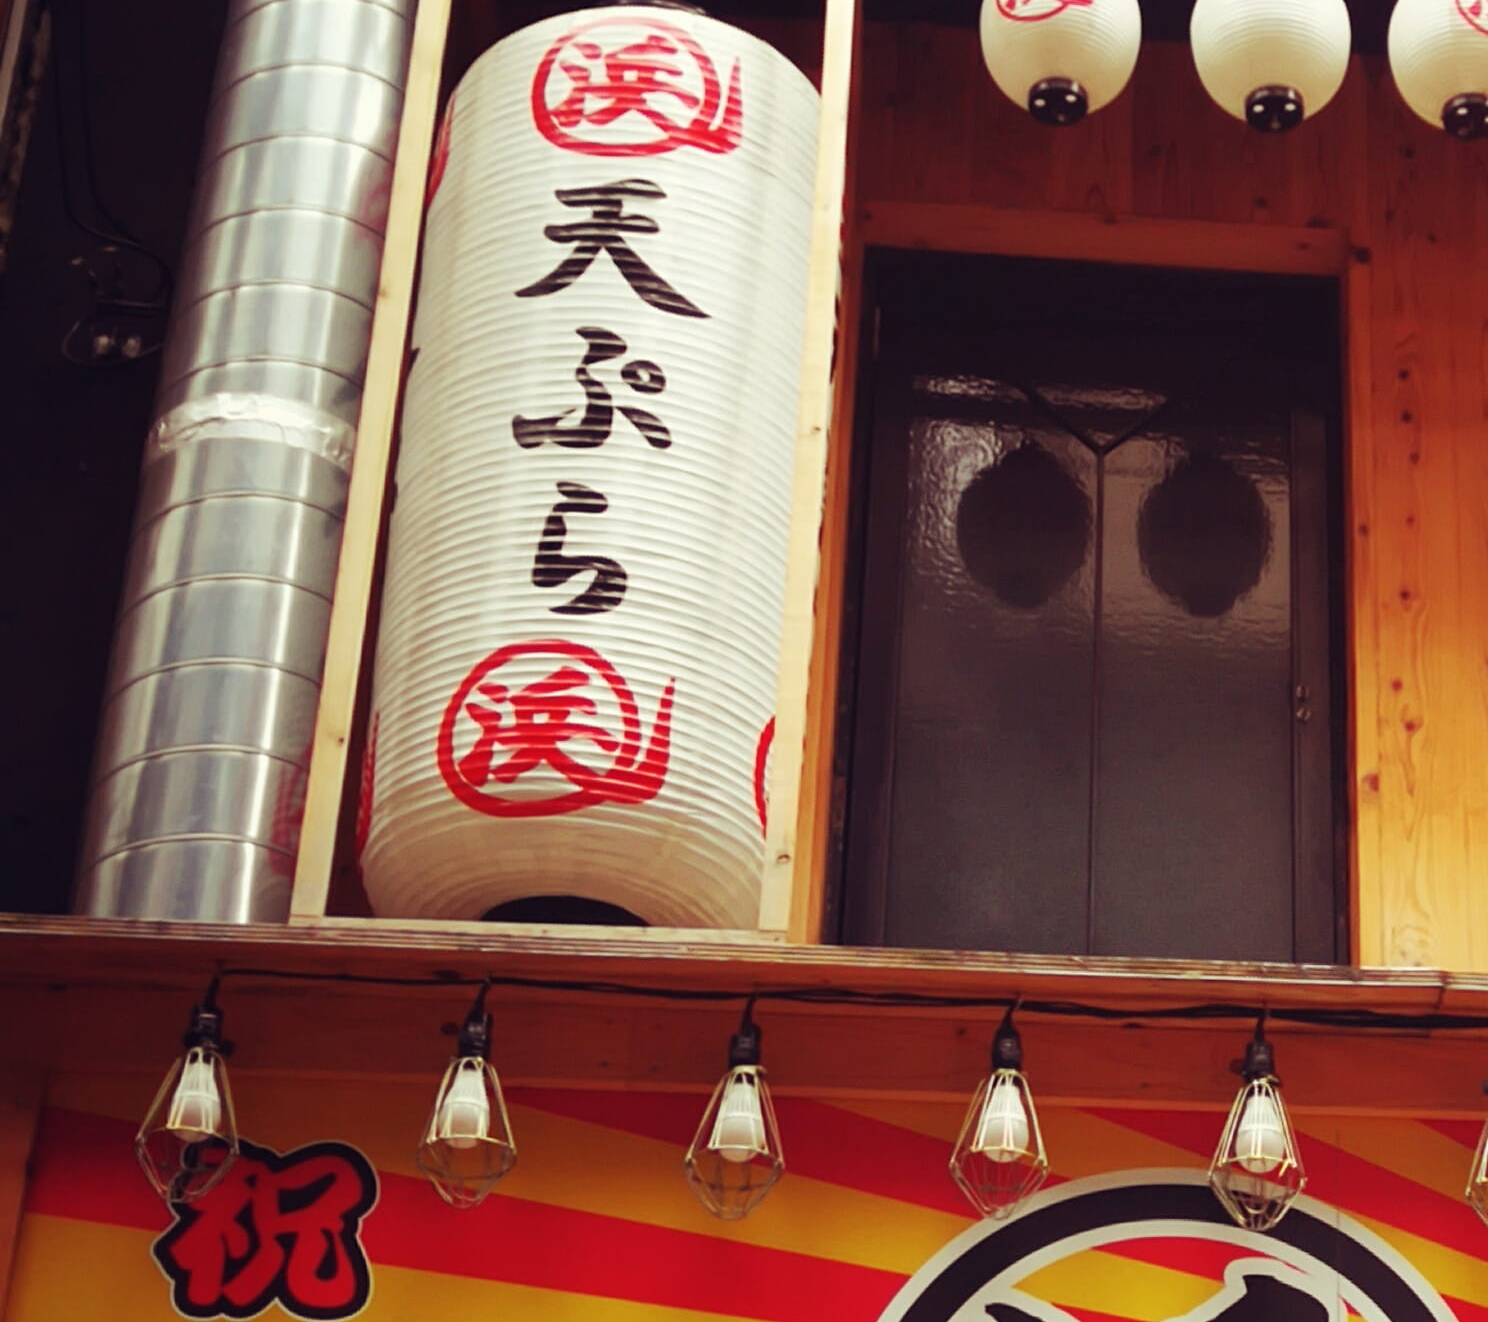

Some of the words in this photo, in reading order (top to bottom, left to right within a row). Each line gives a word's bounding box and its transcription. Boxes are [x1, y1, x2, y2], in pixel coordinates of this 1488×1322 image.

[513, 177, 712, 616] 天ぷら
[152, 1139, 380, 1322] 祝
